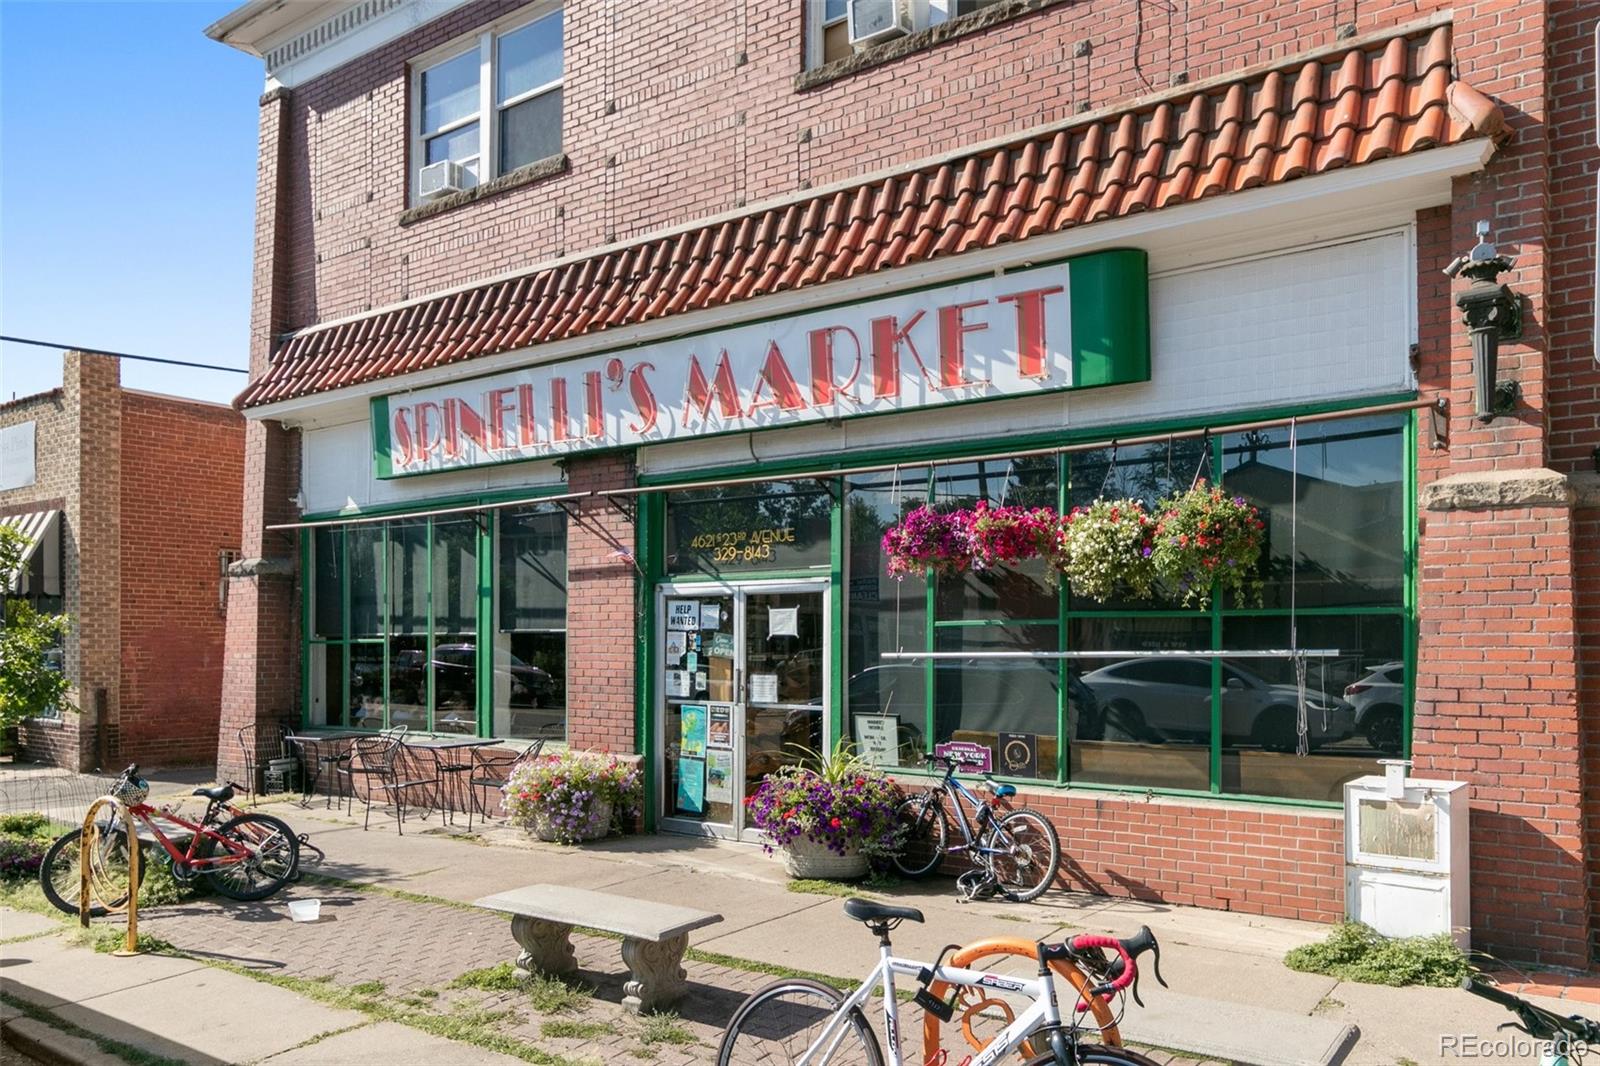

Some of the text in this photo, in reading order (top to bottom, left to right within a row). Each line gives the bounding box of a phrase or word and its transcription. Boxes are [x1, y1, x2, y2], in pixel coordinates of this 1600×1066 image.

[393, 284, 1065, 467] SPINELLI'S MARKET
[691, 533, 715, 548] 4621
[750, 528, 794, 545] AVENUE
[714, 544, 770, 561] 329-8143
[675, 604, 692, 615] HELP
[670, 615, 696, 626] WANTED
[963, 751, 987, 760] YORK
